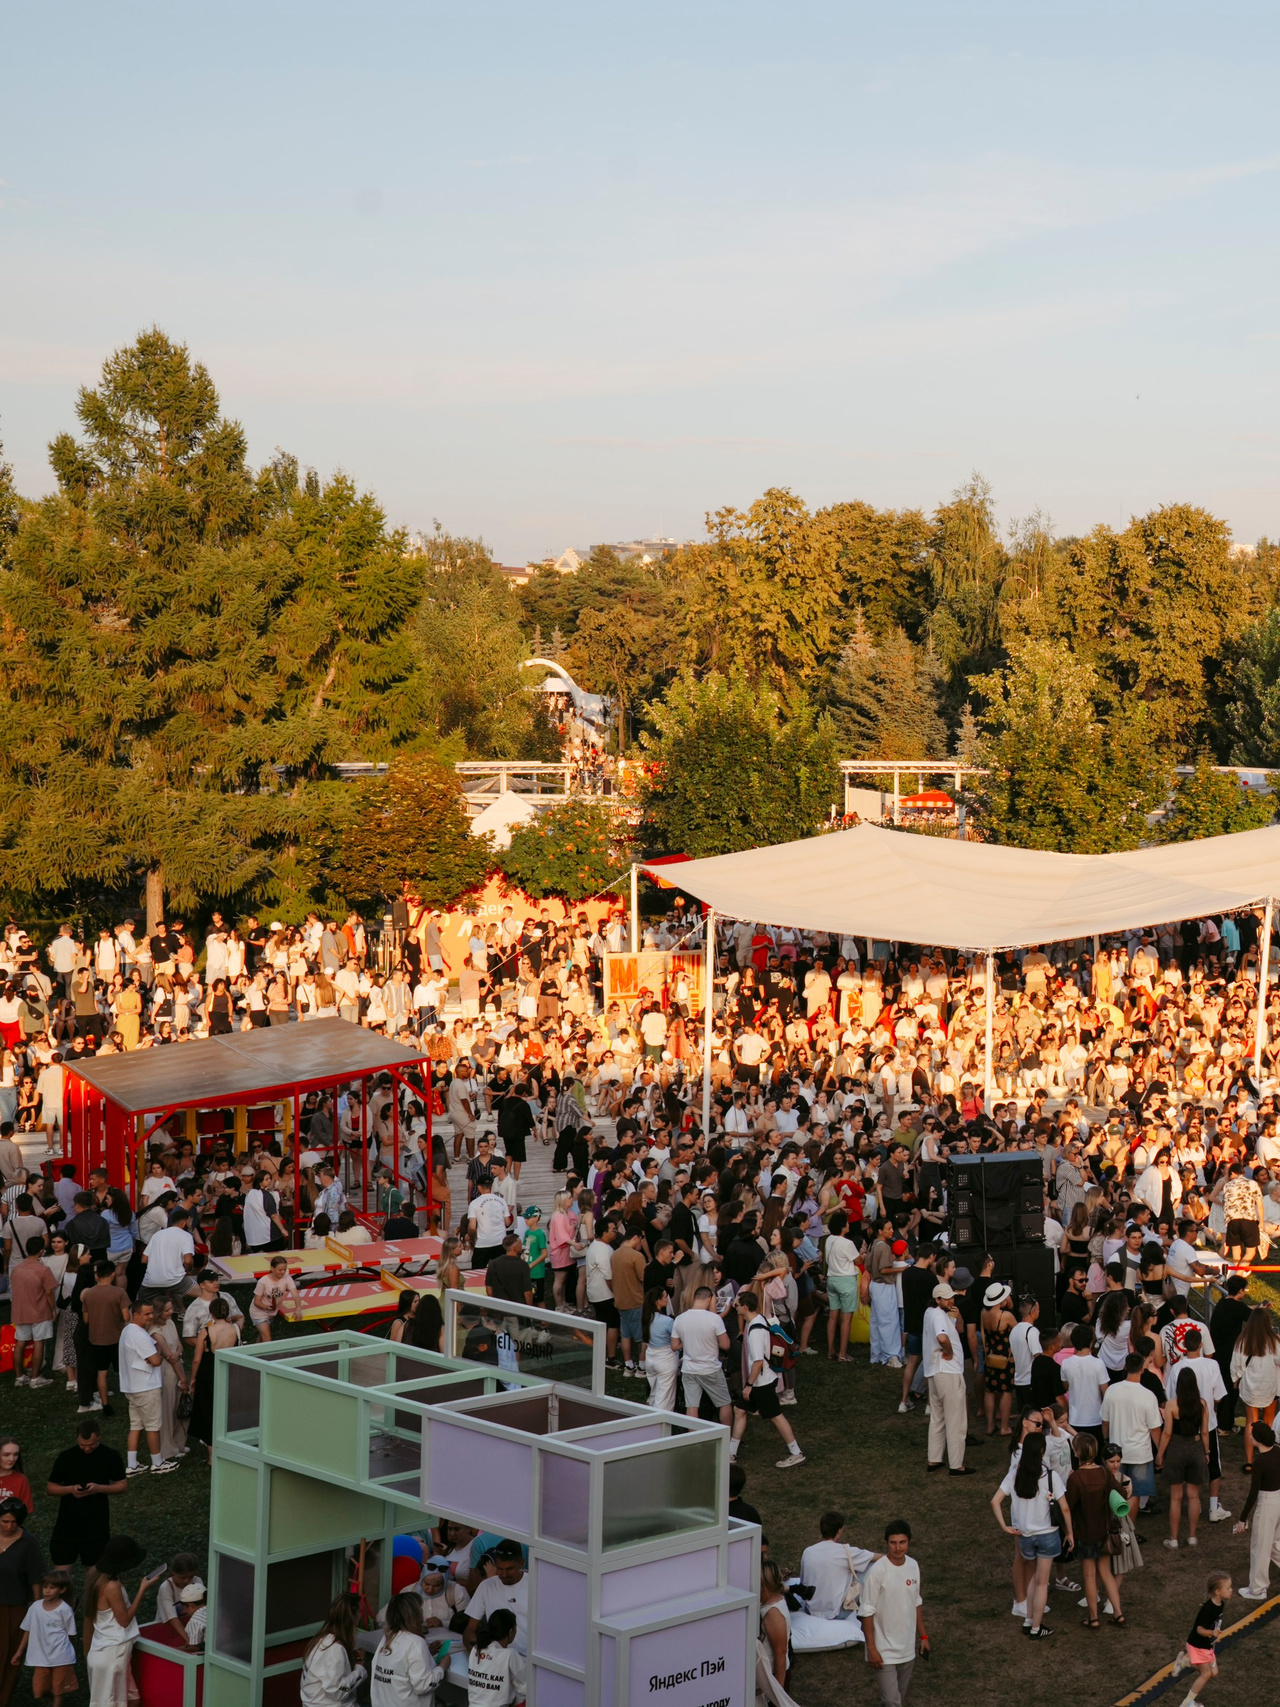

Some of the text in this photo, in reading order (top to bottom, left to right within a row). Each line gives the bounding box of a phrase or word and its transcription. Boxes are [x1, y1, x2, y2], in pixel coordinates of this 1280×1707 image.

[490, 1674, 505, 1682] КАК
[649, 1657, 725, 1692] Яндекс Пэй
[486, 1683, 501, 1691] ВАМ
